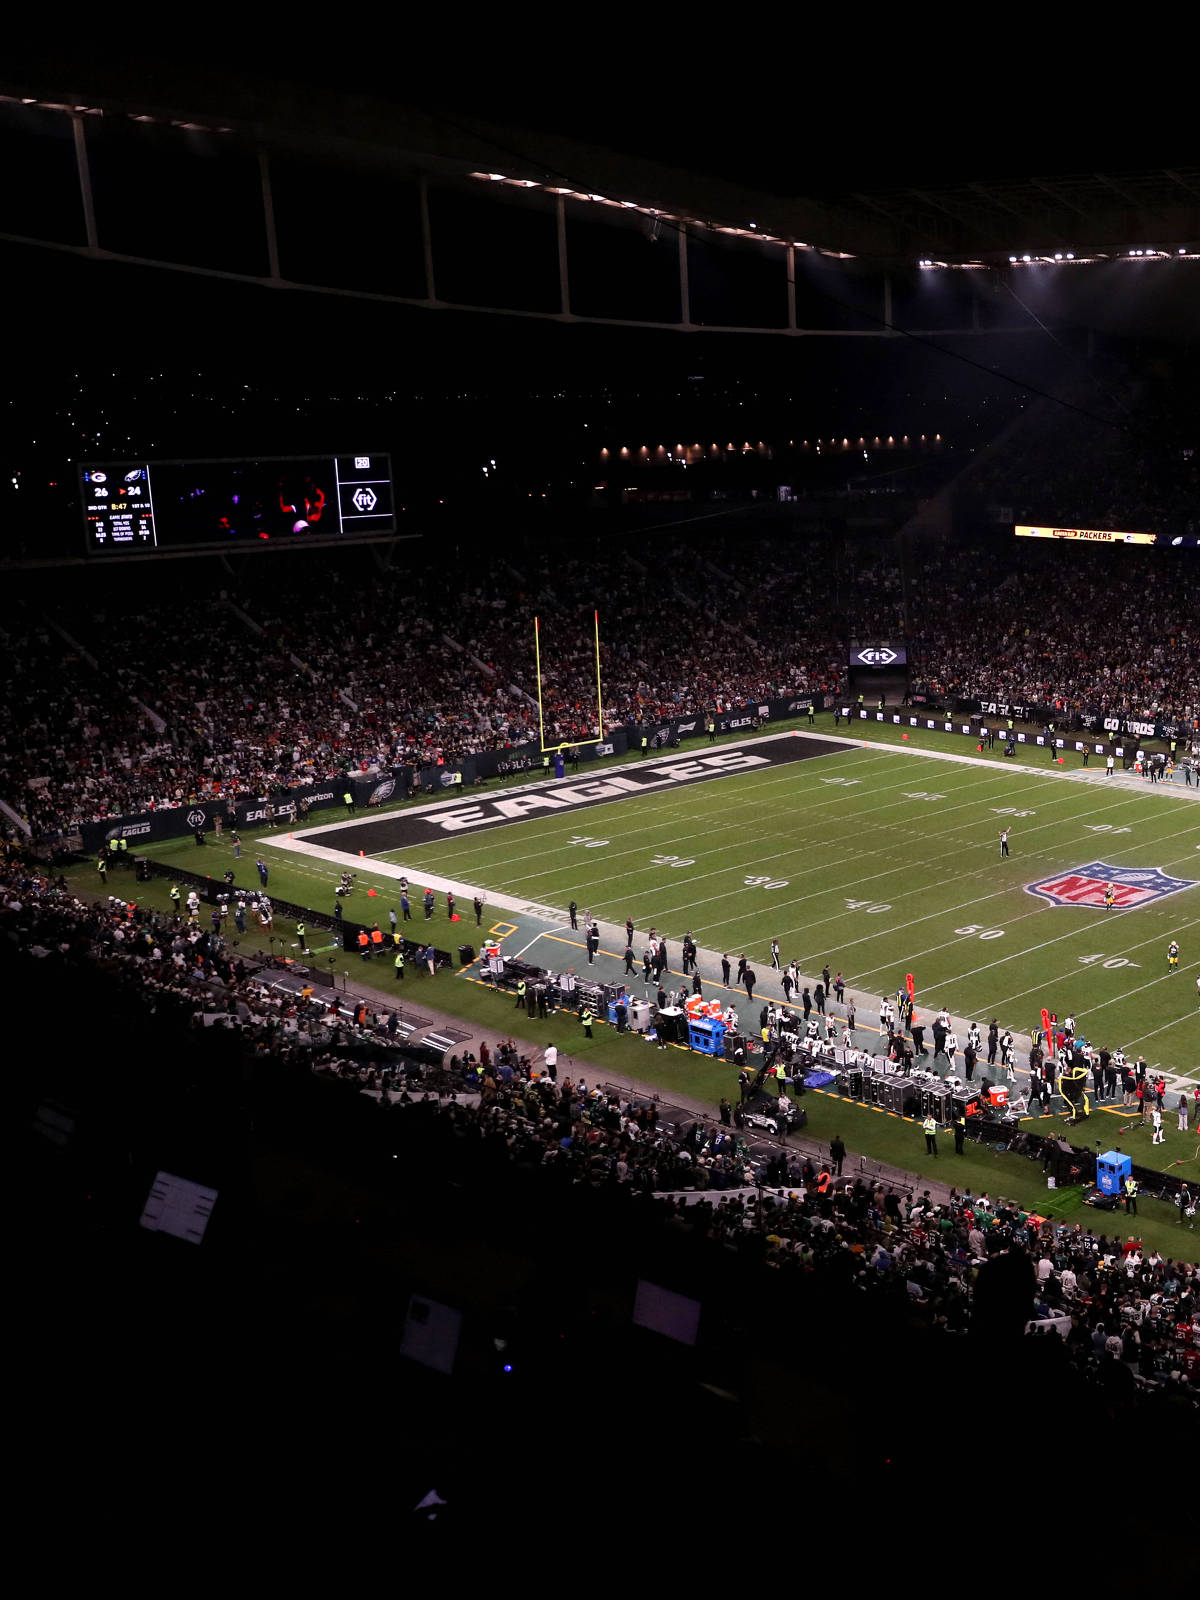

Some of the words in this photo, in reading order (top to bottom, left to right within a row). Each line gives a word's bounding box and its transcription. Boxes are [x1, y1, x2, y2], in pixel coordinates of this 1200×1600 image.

[94, 487, 109, 497] 26
[127, 486, 141, 496] 24
[357, 494, 374, 507] fit
[1079, 531, 1112, 541] PACKERS
[865, 652, 890, 661] fit
[1104, 717, 1119, 731] GO
[304, 792, 334, 803] verizon
[420, 752, 771, 831] EAGLES
[191, 815, 202, 824] fit
[122, 825, 151, 837] EAGLES
[651, 856, 696, 867] 20
[744, 877, 789, 890] 30
[1036, 874, 1162, 906] NFL
[846, 900, 892, 914] 40
[954, 924, 1006, 940] 50
[1078, 953, 1130, 969] 40
